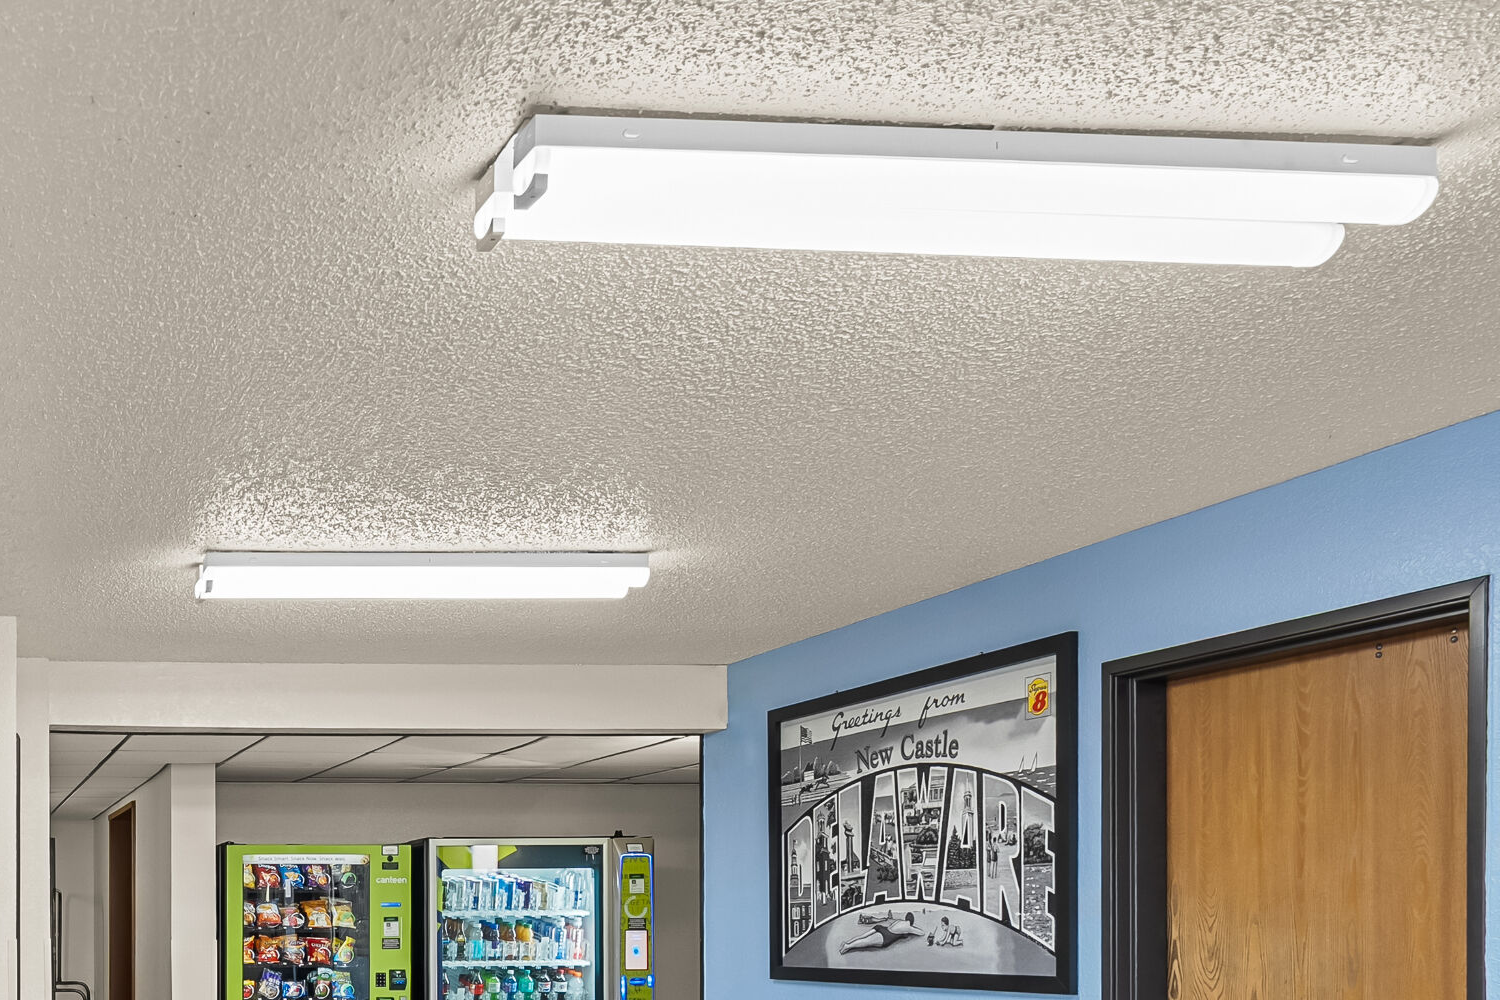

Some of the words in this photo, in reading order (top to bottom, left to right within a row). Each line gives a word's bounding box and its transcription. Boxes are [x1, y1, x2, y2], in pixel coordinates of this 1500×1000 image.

[831, 706, 902, 751] Greetings
[918, 692, 966, 729] from
[1032, 690, 1047, 713] 8
[854, 745, 894, 774] New
[900, 729, 960, 762] Castle
[375, 876, 408, 884] canteen
[787, 766, 1056, 953] DELAWARE
